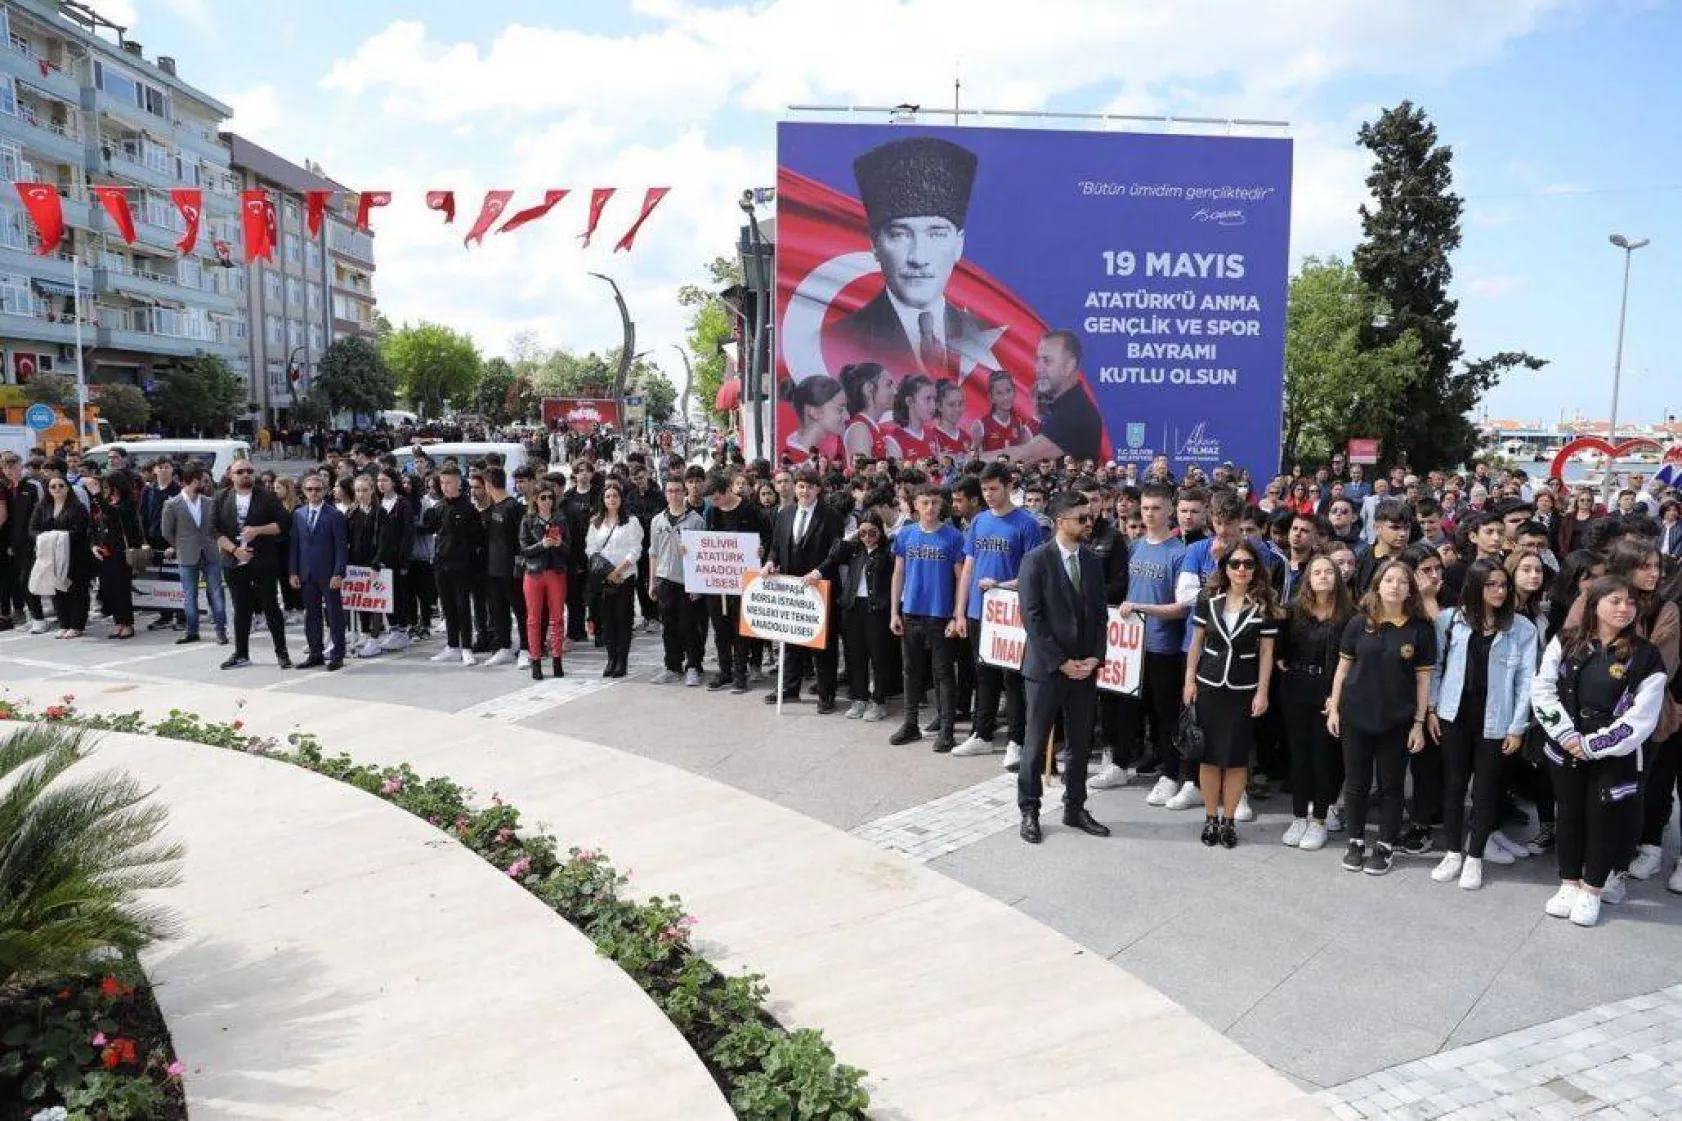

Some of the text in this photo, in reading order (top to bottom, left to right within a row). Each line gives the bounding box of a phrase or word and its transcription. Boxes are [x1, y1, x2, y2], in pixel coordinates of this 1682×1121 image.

[1129, 183, 1183, 197] ümidim
[1102, 251, 1246, 279] 19 MAYIS
[1084, 289, 1261, 311] ATATÜRK'Ü ANMA
[1083, 314, 1260, 337] GENÇLİK VE SPOR
[1127, 342, 1217, 360] BAYRAMI
[1100, 367, 1238, 385] KUTLU OLSUN
[700, 536, 738, 549] SİLİVRİ
[342, 579, 371, 593] nal
[341, 593, 386, 609] ulları
[751, 592, 816, 611] BORSA İSTANBUL
[751, 618, 788, 633] ANADOLU
[780, 610, 789, 620] VE
[791, 611, 820, 625] TEKNİK
[1109, 621, 1141, 650] OLU
